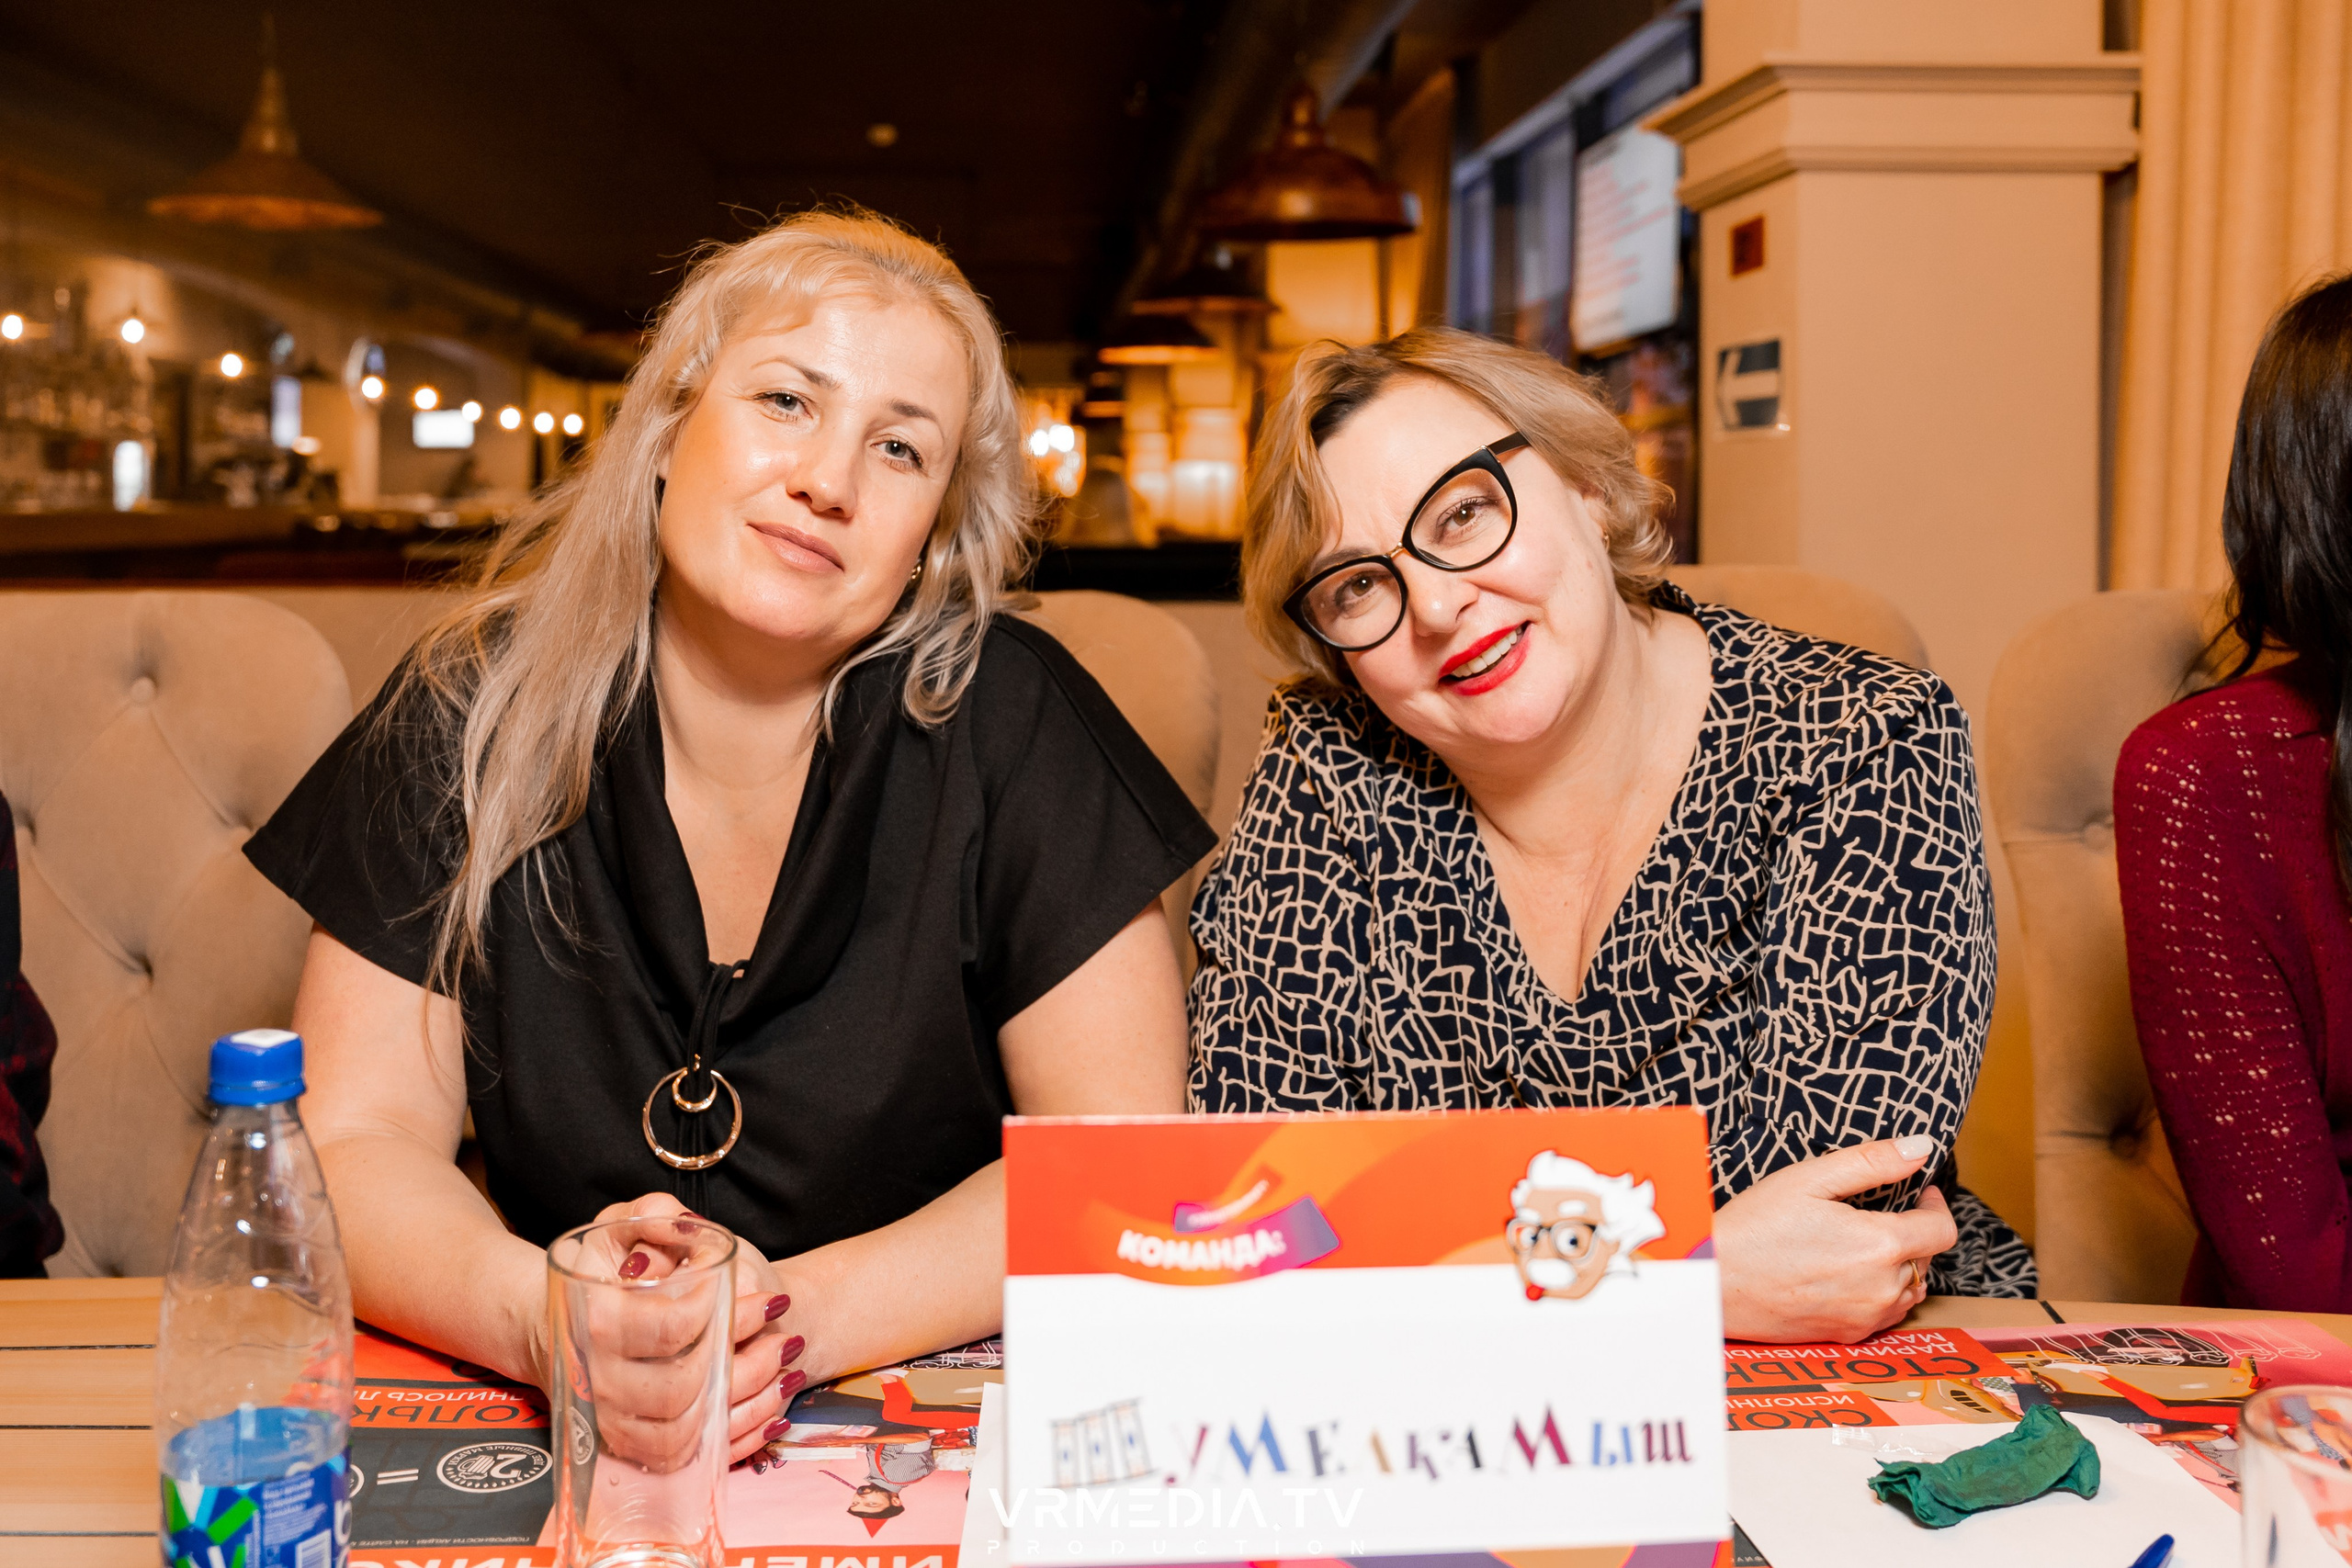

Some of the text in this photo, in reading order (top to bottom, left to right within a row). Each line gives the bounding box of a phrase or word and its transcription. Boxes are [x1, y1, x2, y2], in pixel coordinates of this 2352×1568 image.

[1724, 1341, 1959, 1359] ДАРИМ ПИВНЫ
[1725, 1357, 1980, 1383] СТОЛЬК
[1725, 1394, 1855, 1409] ИСПОЛН
[448, 1445, 484, 1466] МАРКИ
[490, 1452, 527, 1479] 2
